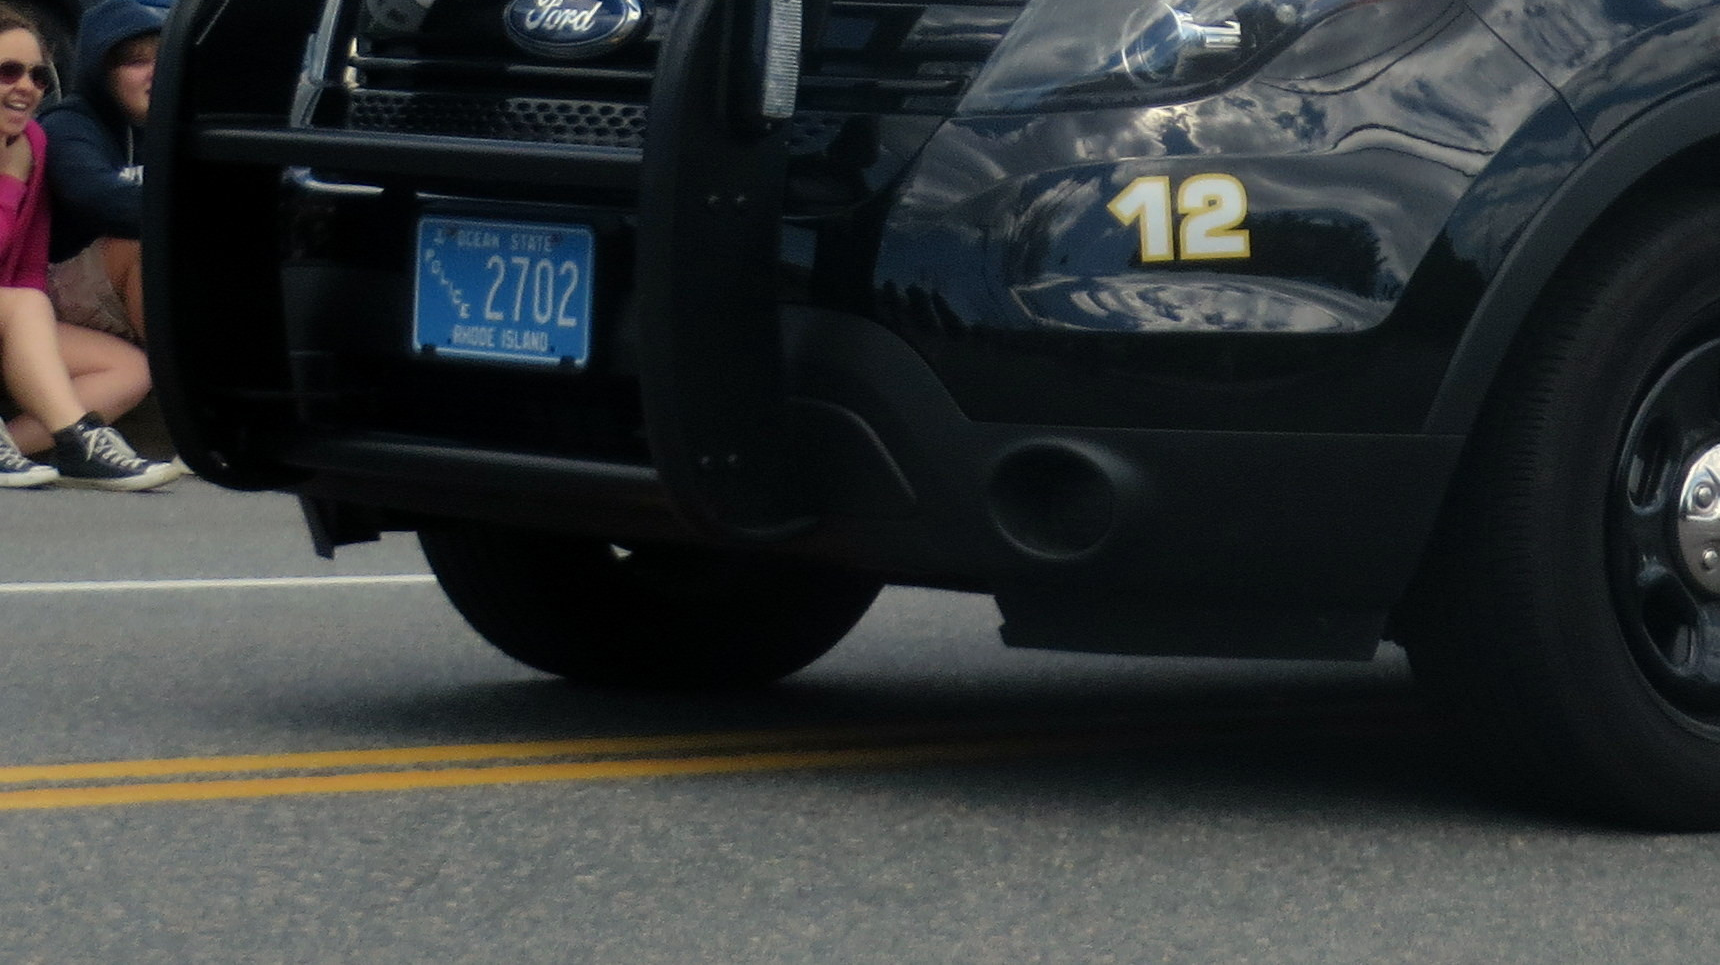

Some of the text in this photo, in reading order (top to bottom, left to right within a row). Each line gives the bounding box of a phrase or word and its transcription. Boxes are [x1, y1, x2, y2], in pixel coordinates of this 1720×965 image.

[511, 234, 553, 252] STATE
[1107, 173, 1251, 263] 12
[425, 249, 471, 319] POLICE
[484, 255, 580, 327] 2702
[453, 325, 549, 352] RHODE ISLAND
